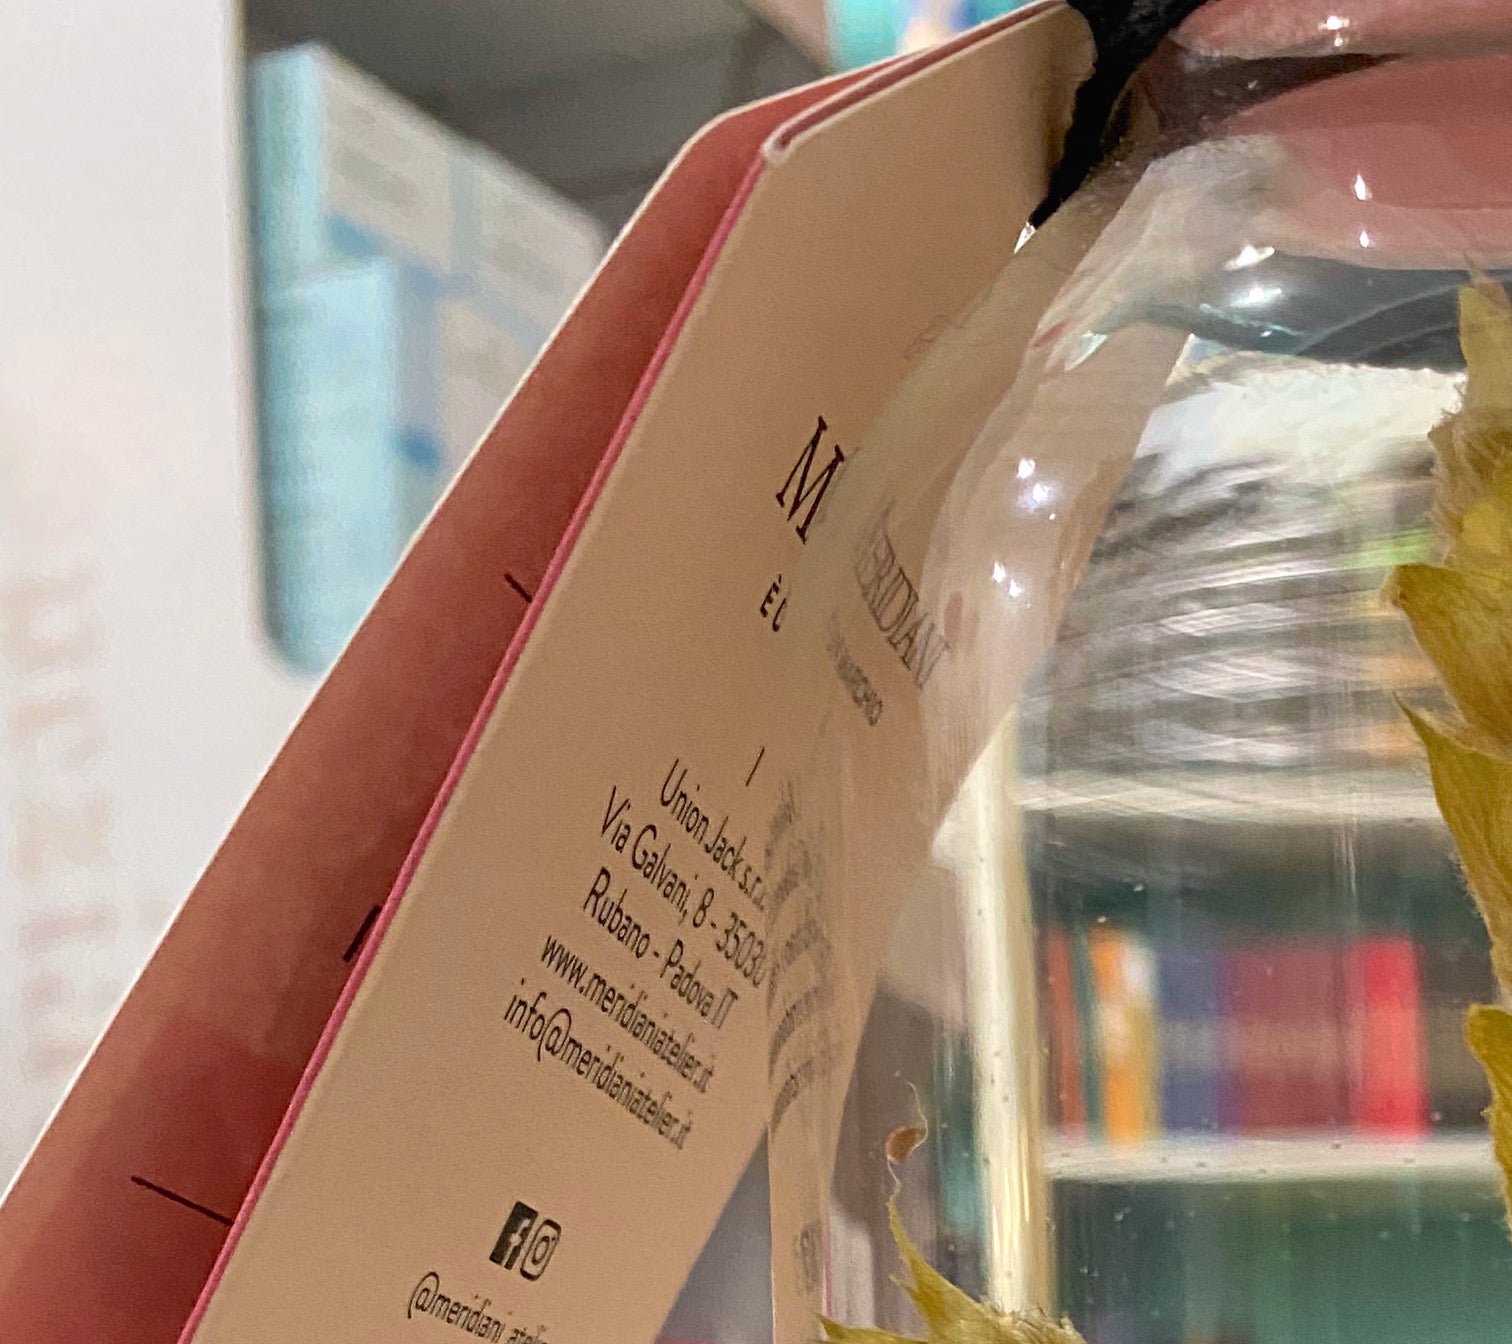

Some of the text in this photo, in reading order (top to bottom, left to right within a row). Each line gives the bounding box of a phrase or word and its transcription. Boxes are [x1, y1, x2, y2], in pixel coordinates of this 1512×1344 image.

[600, 785, 632, 854] Via
[631, 824, 700, 919] Galvani,
[693, 887, 715, 928] 8
[660, 759, 710, 844] Union
[704, 816, 747, 880] Jack
[583, 866, 651, 958] Rubano
[660, 939, 714, 1018] Padova
[503, 977, 694, 1150] info@meridianiatelier.it
